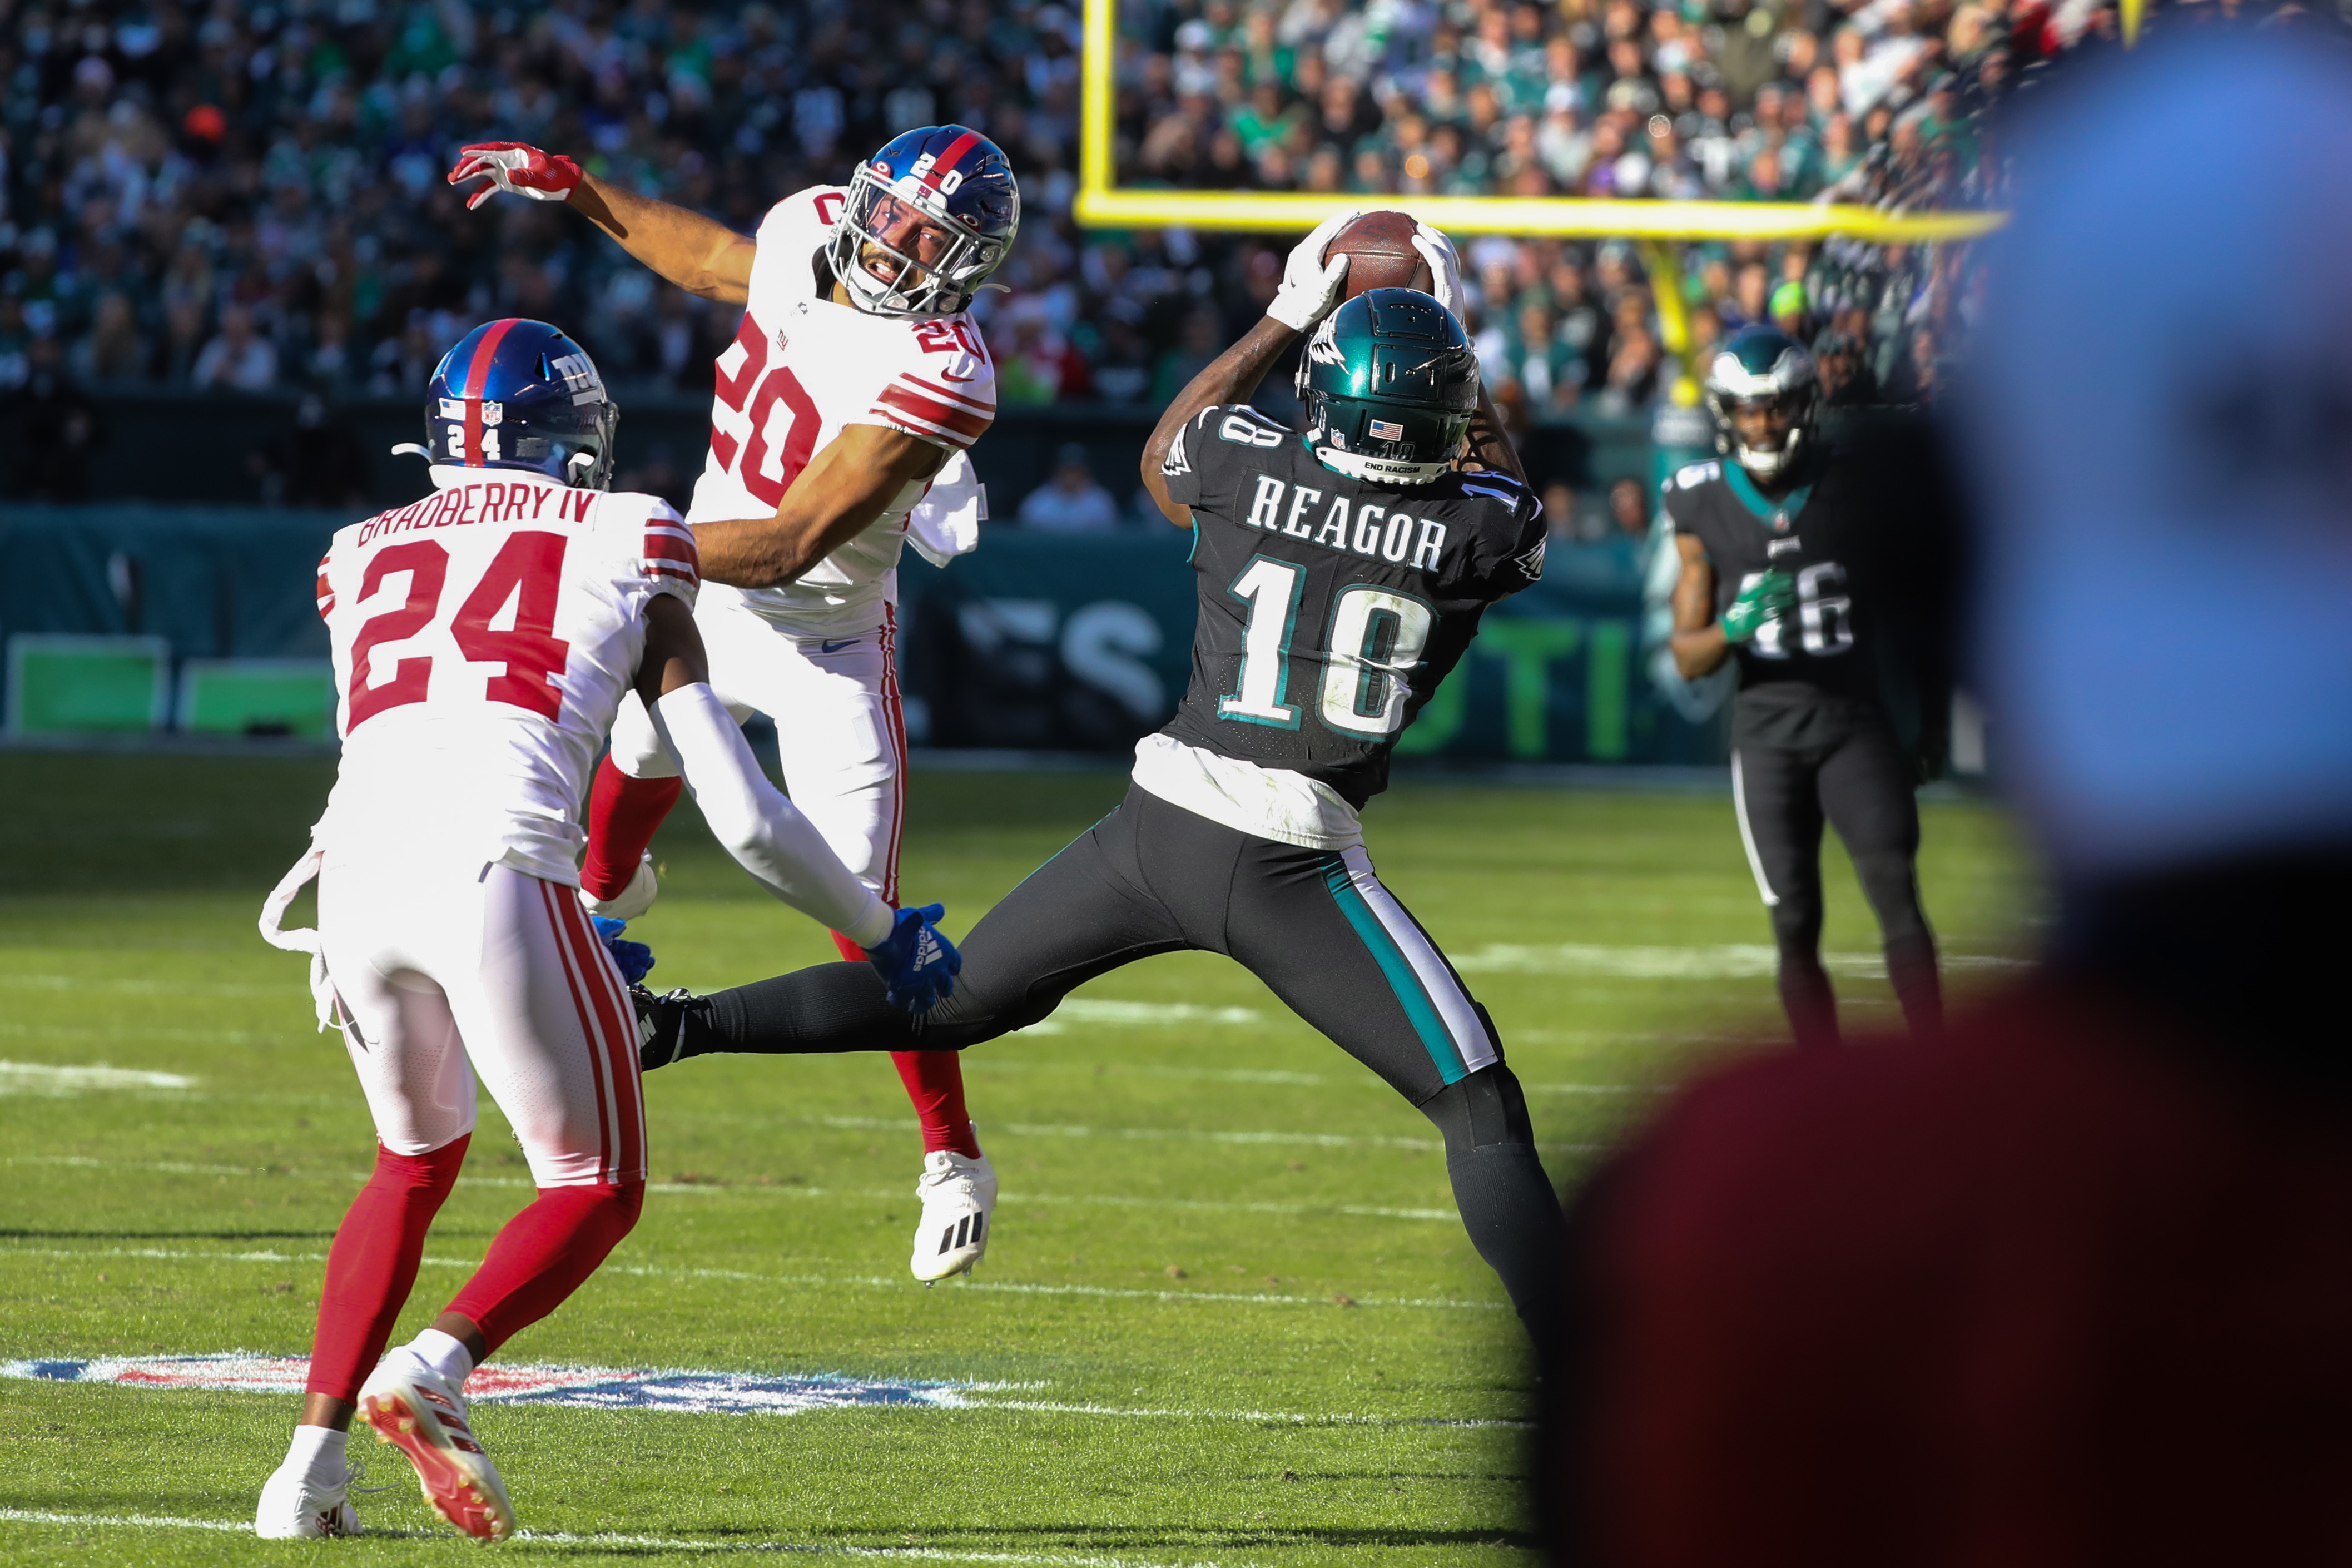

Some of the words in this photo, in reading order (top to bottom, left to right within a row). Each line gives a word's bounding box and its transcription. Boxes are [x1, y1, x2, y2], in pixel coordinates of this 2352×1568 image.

[910, 152, 964, 195] 20
[447, 424, 501, 460] 24
[710, 311, 822, 510] 20
[1364, 462, 1383, 471] END
[358, 483, 553, 548] BRADBERRY
[559, 490, 596, 523] IV
[1244, 472, 1448, 575] REAGOR
[345, 530, 570, 737] 24
[1216, 553, 1442, 743] 18
[912, 925, 927, 972] adidas
